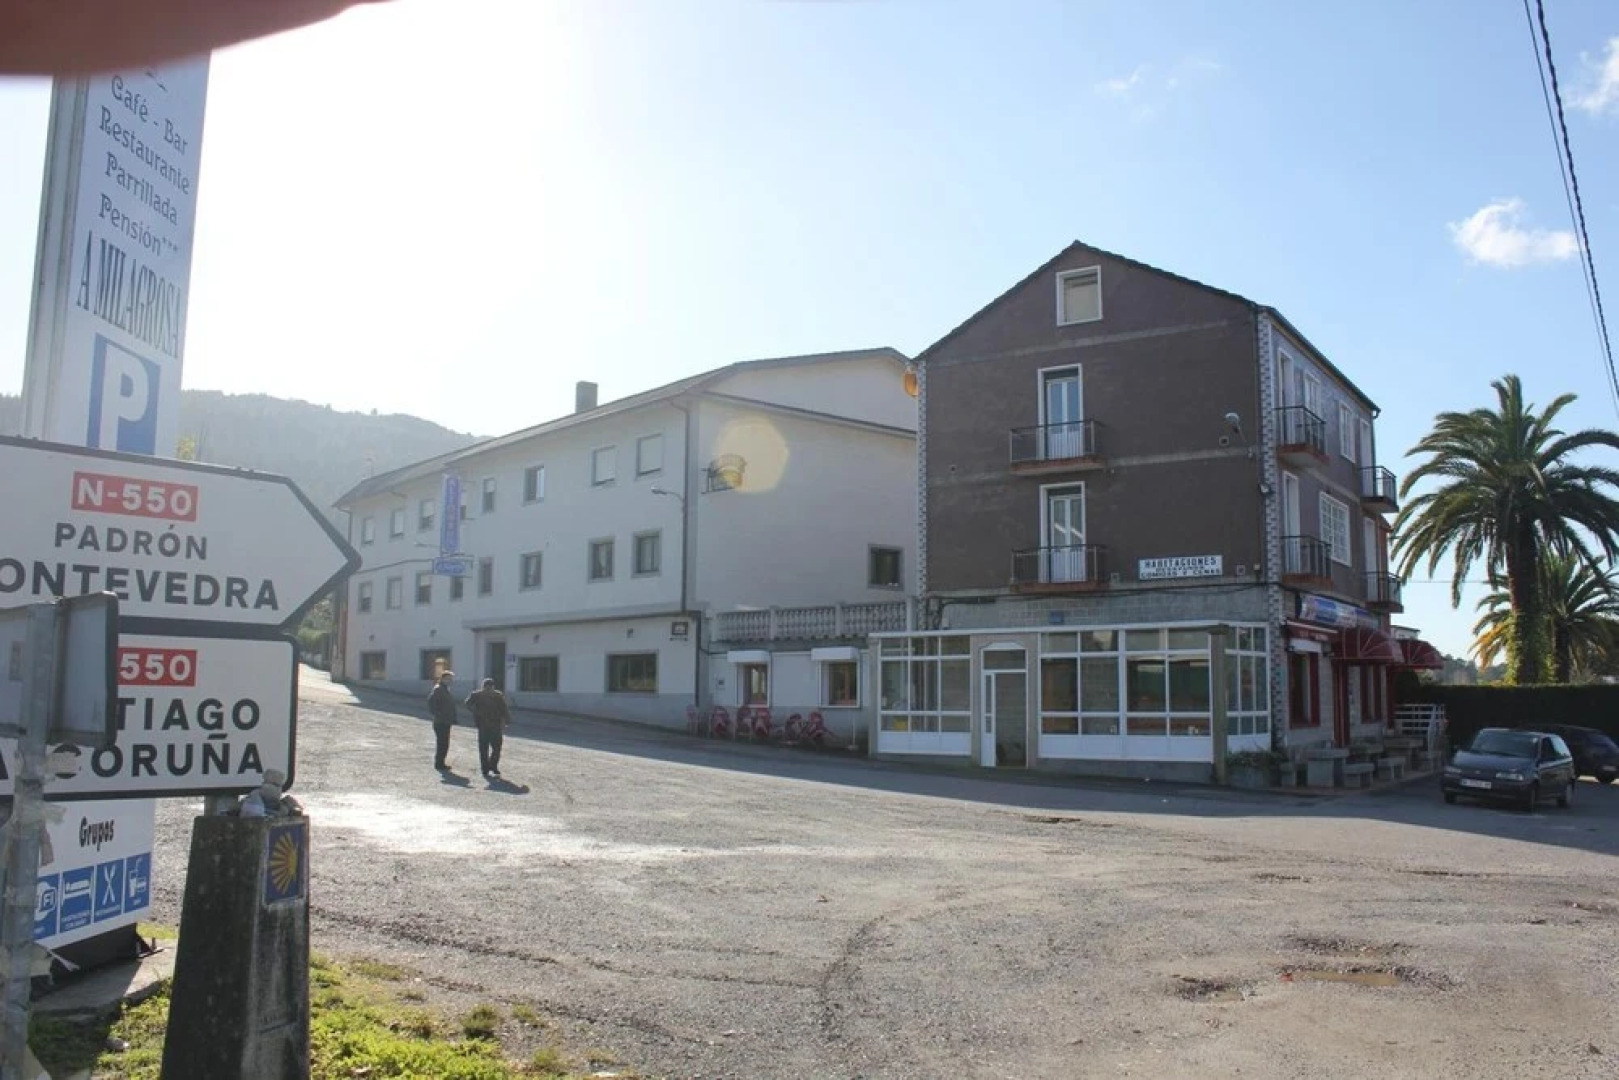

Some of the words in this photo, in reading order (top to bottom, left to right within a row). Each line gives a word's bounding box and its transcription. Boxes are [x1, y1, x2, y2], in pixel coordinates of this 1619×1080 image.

[111, 75, 148, 123] Café
[164, 118, 188, 155] Bar
[99, 105, 190, 194] Restaurante
[105, 152, 178, 225] Parrillada
[76, 229, 93, 312] A
[93, 237, 182, 358] MILAGROSA
[77, 478, 193, 516] N-550
[55, 522, 207, 560] PADRÓN
[1145, 556, 1217, 568] HABITACIONES
[79, 816, 115, 851] Grupos
